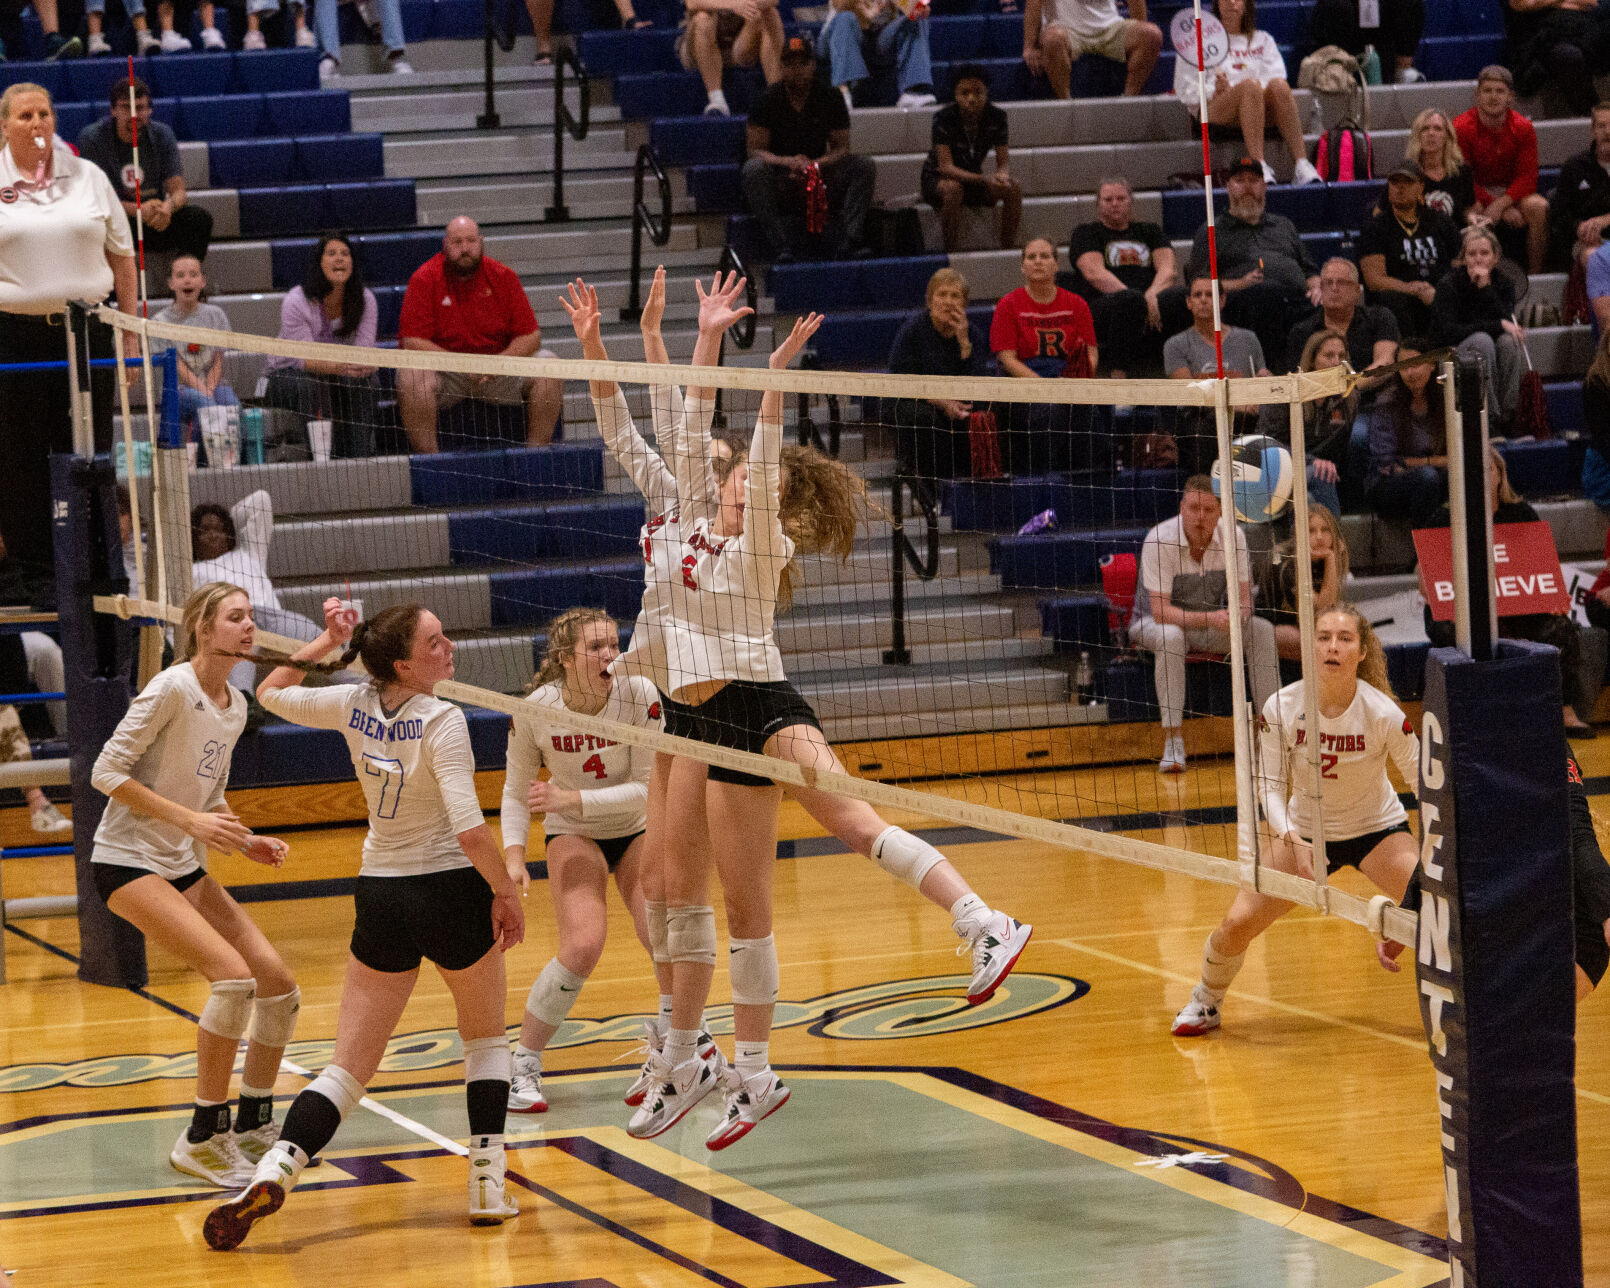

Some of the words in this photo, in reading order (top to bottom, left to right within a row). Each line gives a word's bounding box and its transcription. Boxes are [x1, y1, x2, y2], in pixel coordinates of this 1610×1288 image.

[1035, 327, 1068, 358] R
[1493, 543, 1510, 563] E
[1434, 572, 1558, 602] BIEVE
[348, 707, 423, 742] BENWOOD
[551, 733, 622, 753] RAPTO
[1295, 728, 1366, 753] RPTORS
[197, 740, 227, 780] 21
[582, 753, 608, 780] 4
[1320, 753, 1339, 780] 2
[361, 751, 405, 819] 7
